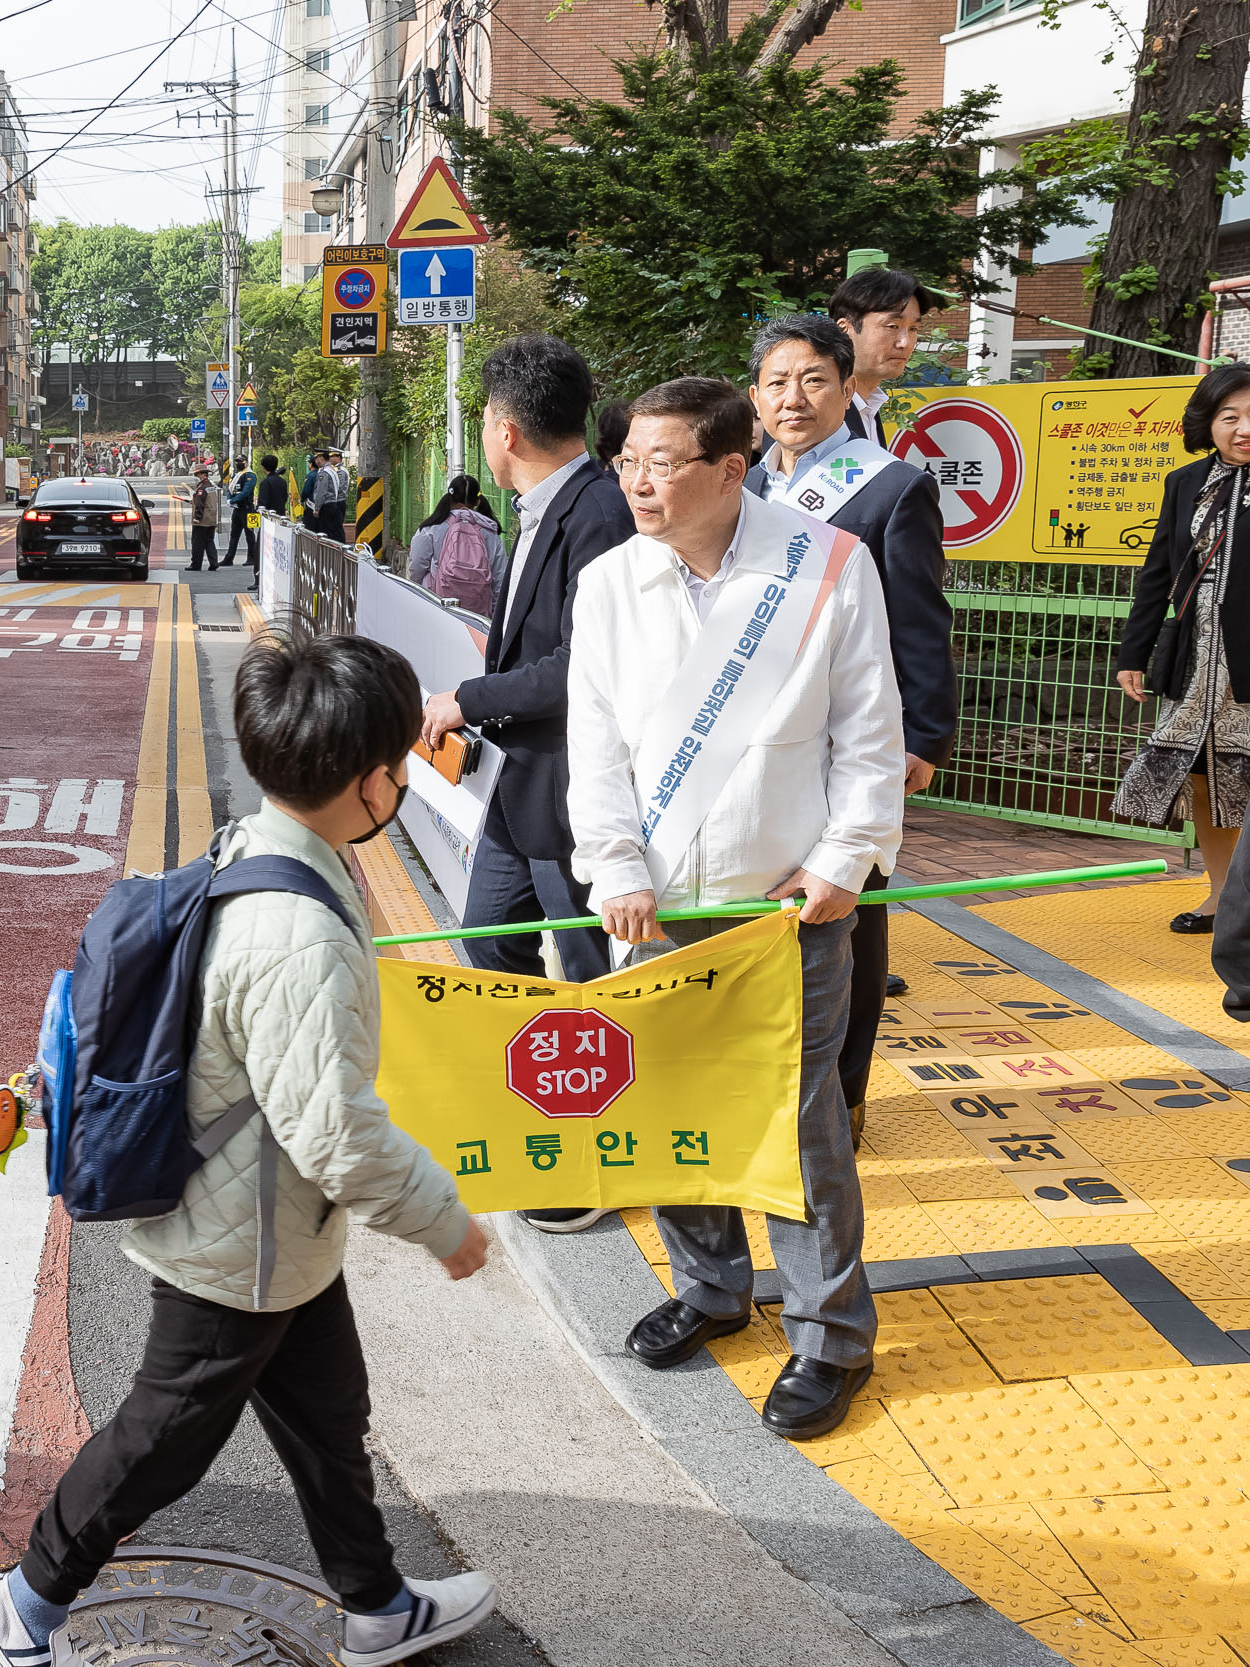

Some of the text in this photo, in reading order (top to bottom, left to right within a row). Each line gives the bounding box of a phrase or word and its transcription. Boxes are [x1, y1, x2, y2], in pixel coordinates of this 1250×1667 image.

[327, 248, 385, 262] 어린이보호구역
[340, 284, 370, 294] 주정차금지
[406, 301, 468, 318] 일방통행
[335, 317, 373, 327] 견인지역
[1048, 423, 1084, 438] 스쿨존
[1086, 421, 1132, 438] 이것만은
[1133, 421, 1148, 437] 꼭
[1079, 442, 1169, 453] 시속 30km 이하 서행
[1078, 457, 1175, 468] 불법 주차 및 정차 금지
[1077, 472, 1160, 483] 급제동, 급출발 금지
[1076, 487, 1125, 497] 역주행 금지
[1075, 502, 1155, 512] 횡단보도 일단 정지
[734, 583, 787, 660] 아이들의
[691, 659, 745, 736] 등하굣길
[651, 736, 702, 809] 안전하게
[536, 1067, 607, 1096] STOP
